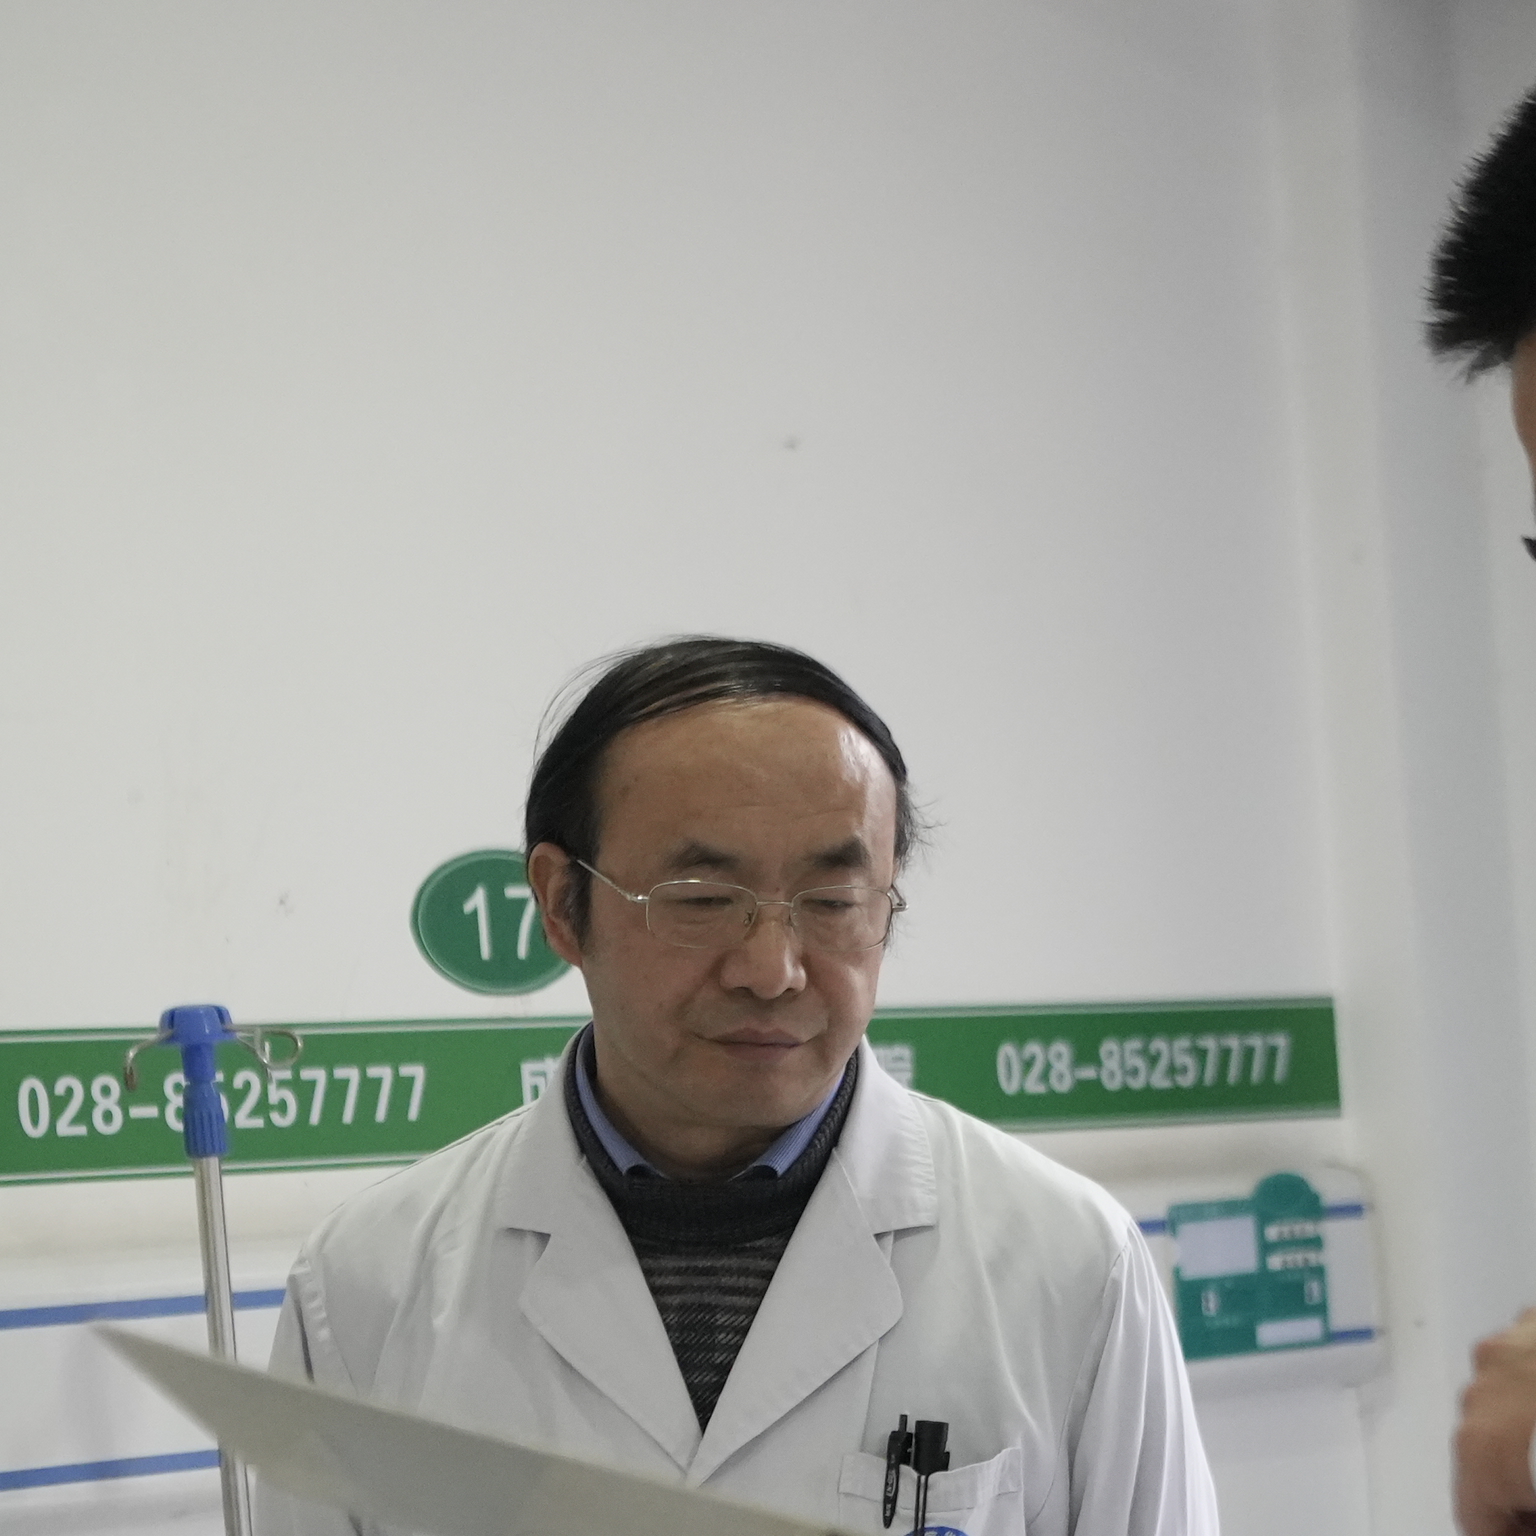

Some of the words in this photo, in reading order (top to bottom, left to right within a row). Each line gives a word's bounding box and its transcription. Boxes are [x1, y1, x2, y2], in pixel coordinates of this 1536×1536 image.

[463, 884, 536, 961] 17
[17, 1064, 426, 1139] 028-8257777
[995, 1030, 1292, 1095] 028-85257777
